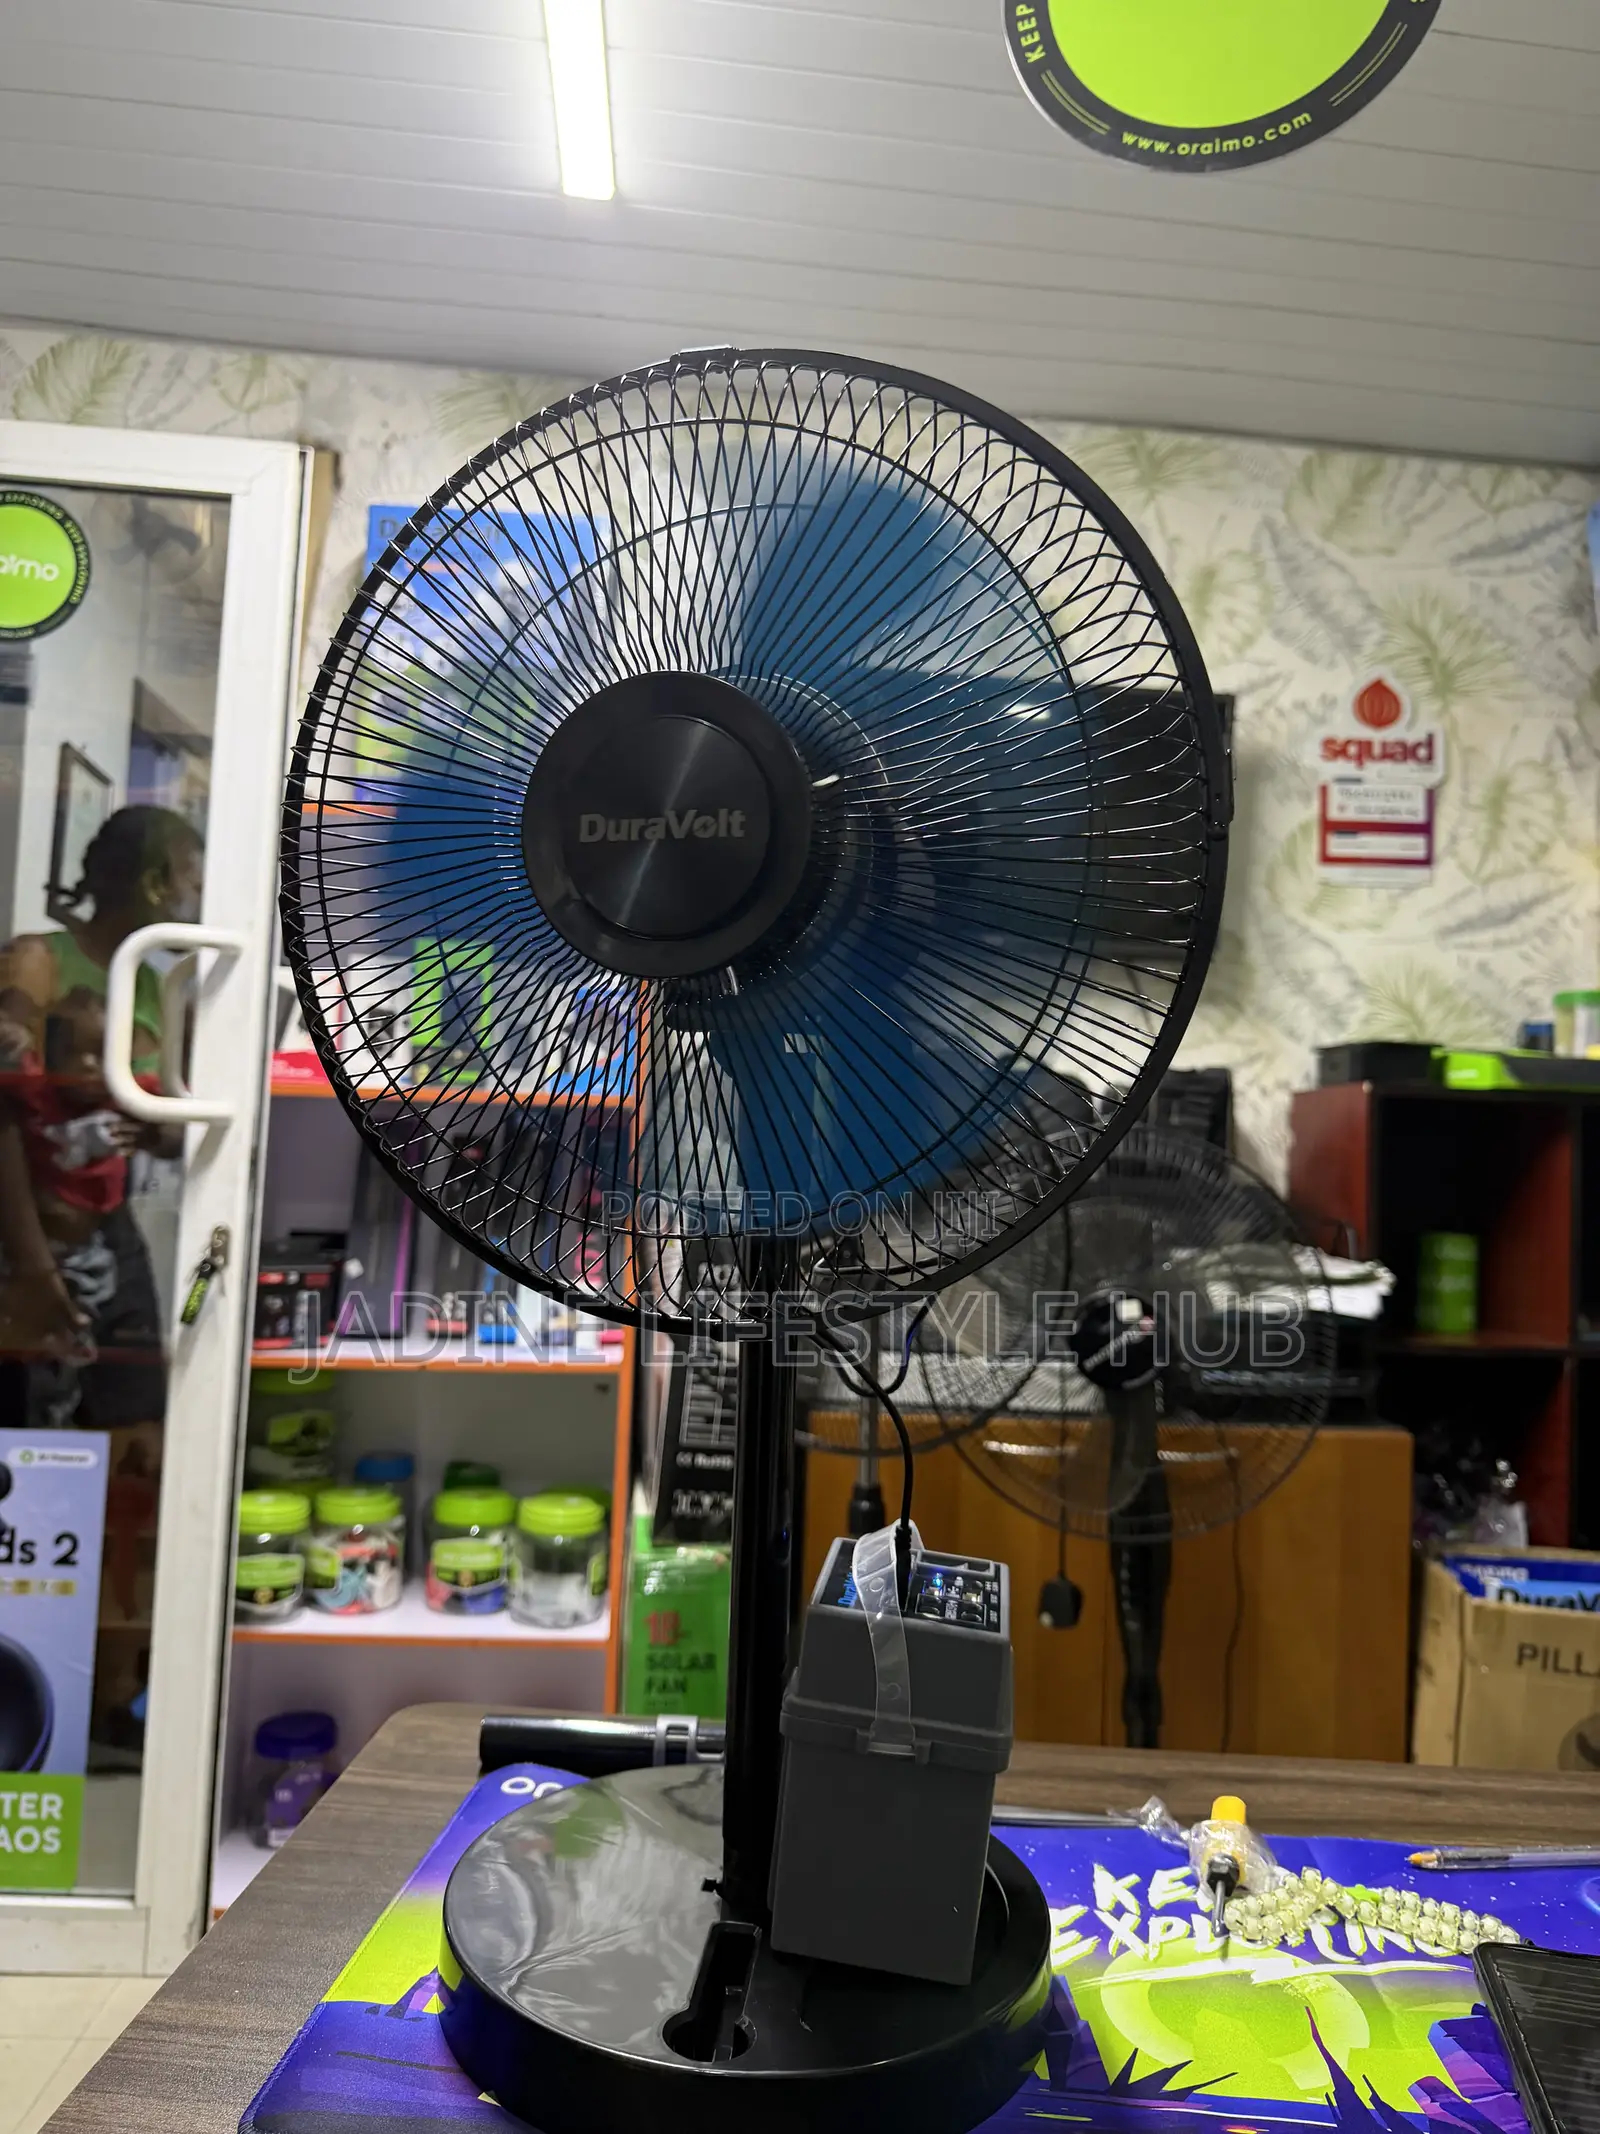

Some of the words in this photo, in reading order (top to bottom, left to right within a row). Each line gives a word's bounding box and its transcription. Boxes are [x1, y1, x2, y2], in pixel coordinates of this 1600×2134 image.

[1016, 4, 1046, 63] KEEP
[1121, 112, 1313, 156] www.oraimo.com
[1320, 732, 1435, 769] squad
[579, 808, 747, 843] DuraVolt
[53, 1531, 79, 1567] 2
[1515, 1641, 1600, 1679] PILL
[0, 1791, 64, 1821] TER
